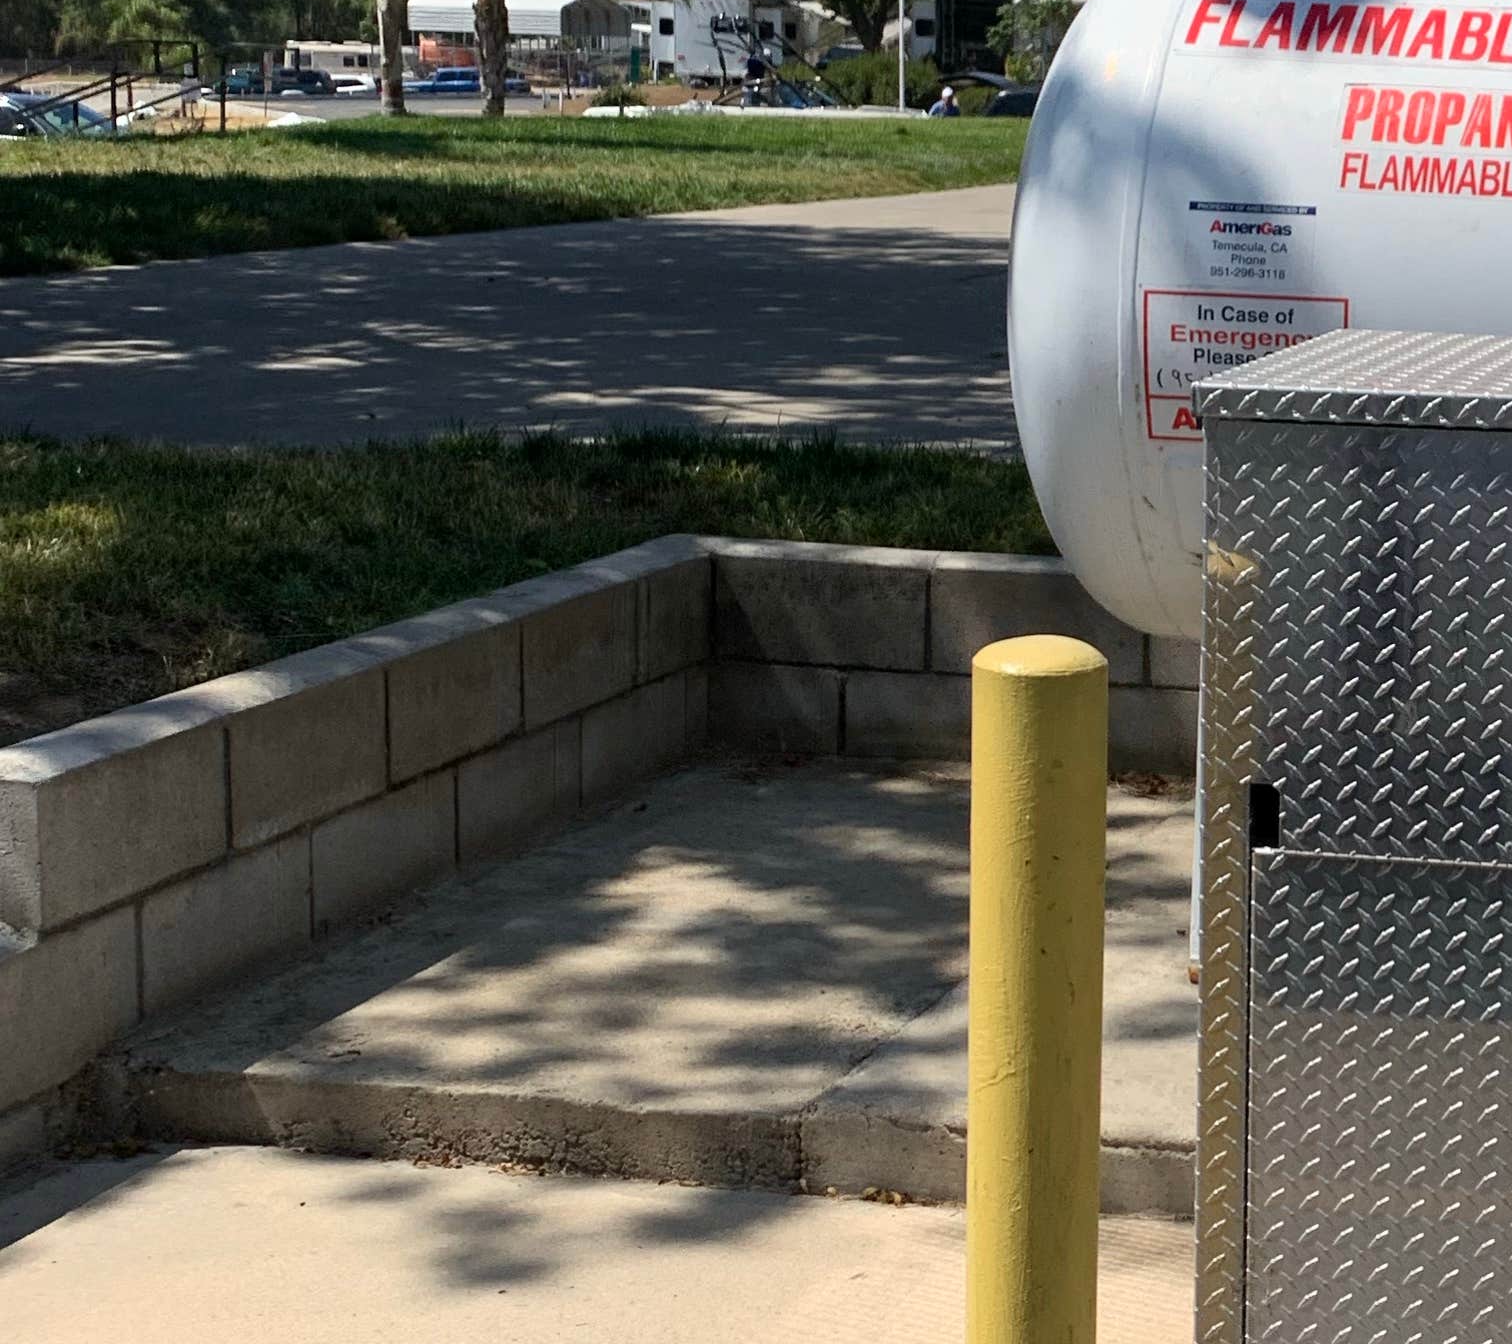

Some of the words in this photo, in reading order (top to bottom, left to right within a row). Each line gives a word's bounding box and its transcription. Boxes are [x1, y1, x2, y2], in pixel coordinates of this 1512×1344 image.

[1210, 219, 1292, 236] AmeriGas
[1212, 240, 1267, 253] Temecula,
[1271, 242, 1288, 254] CA
[1231, 254, 1267, 266] Phone
[1197, 305, 1214, 321] In
[1221, 306, 1269, 324] Case
[1275, 308, 1295, 324] of
[1193, 348, 1257, 365] Please
